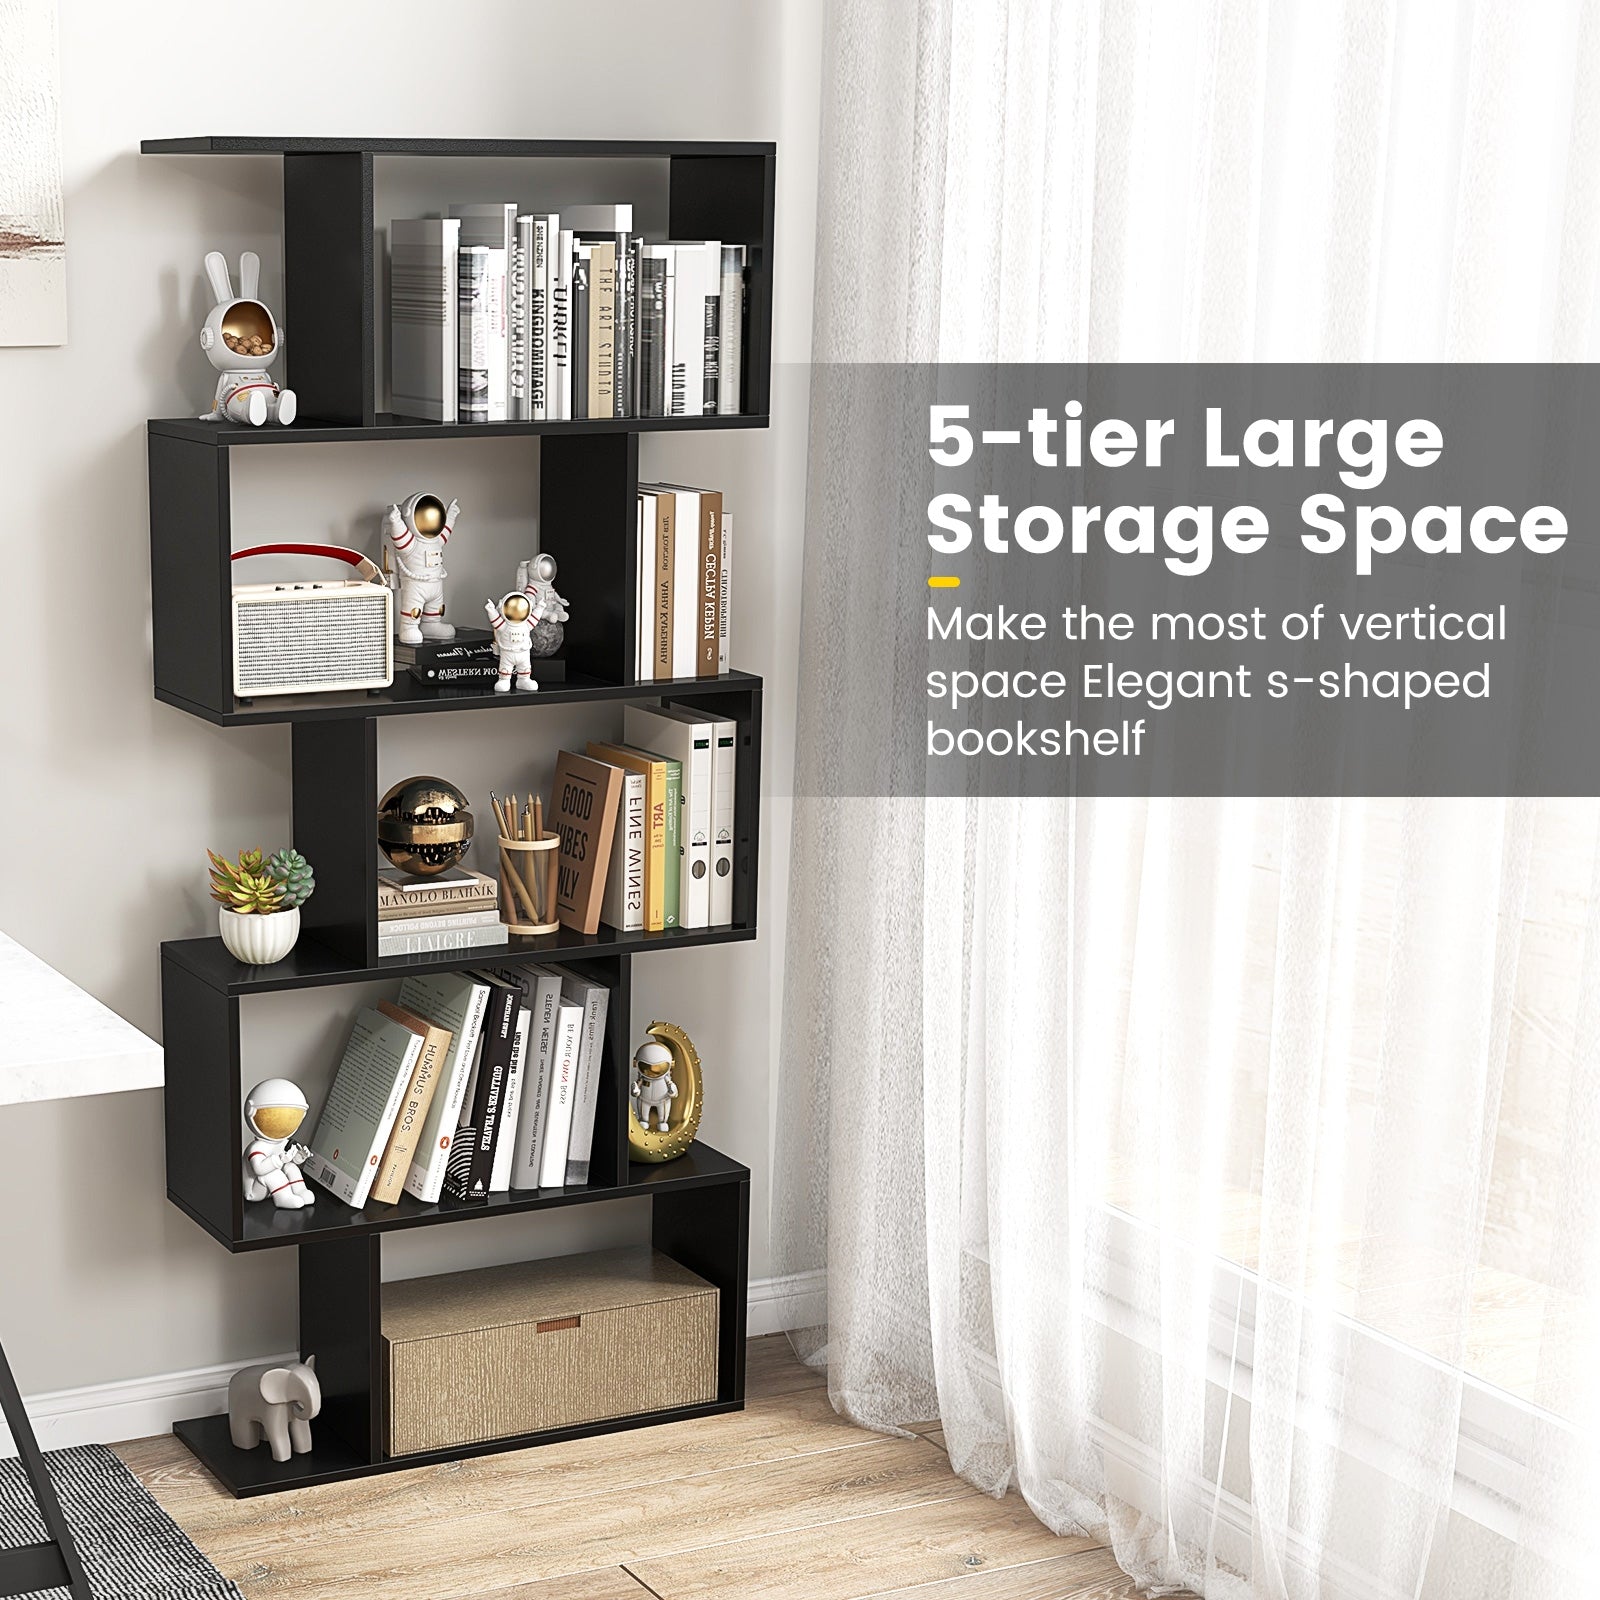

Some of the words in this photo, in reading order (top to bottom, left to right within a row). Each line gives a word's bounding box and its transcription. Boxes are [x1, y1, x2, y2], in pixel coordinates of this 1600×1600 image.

[561, 783, 593, 821] GOOD
[380, 890, 437, 906] MANOLO
[558, 865, 579, 900] NLY
[412, 1044, 440, 1095] HUMMUS
[486, 1064, 502, 1114] GULLIVER'S
[399, 1100, 418, 1134] BROS.
[480, 1112, 494, 1152] TRAVELS
